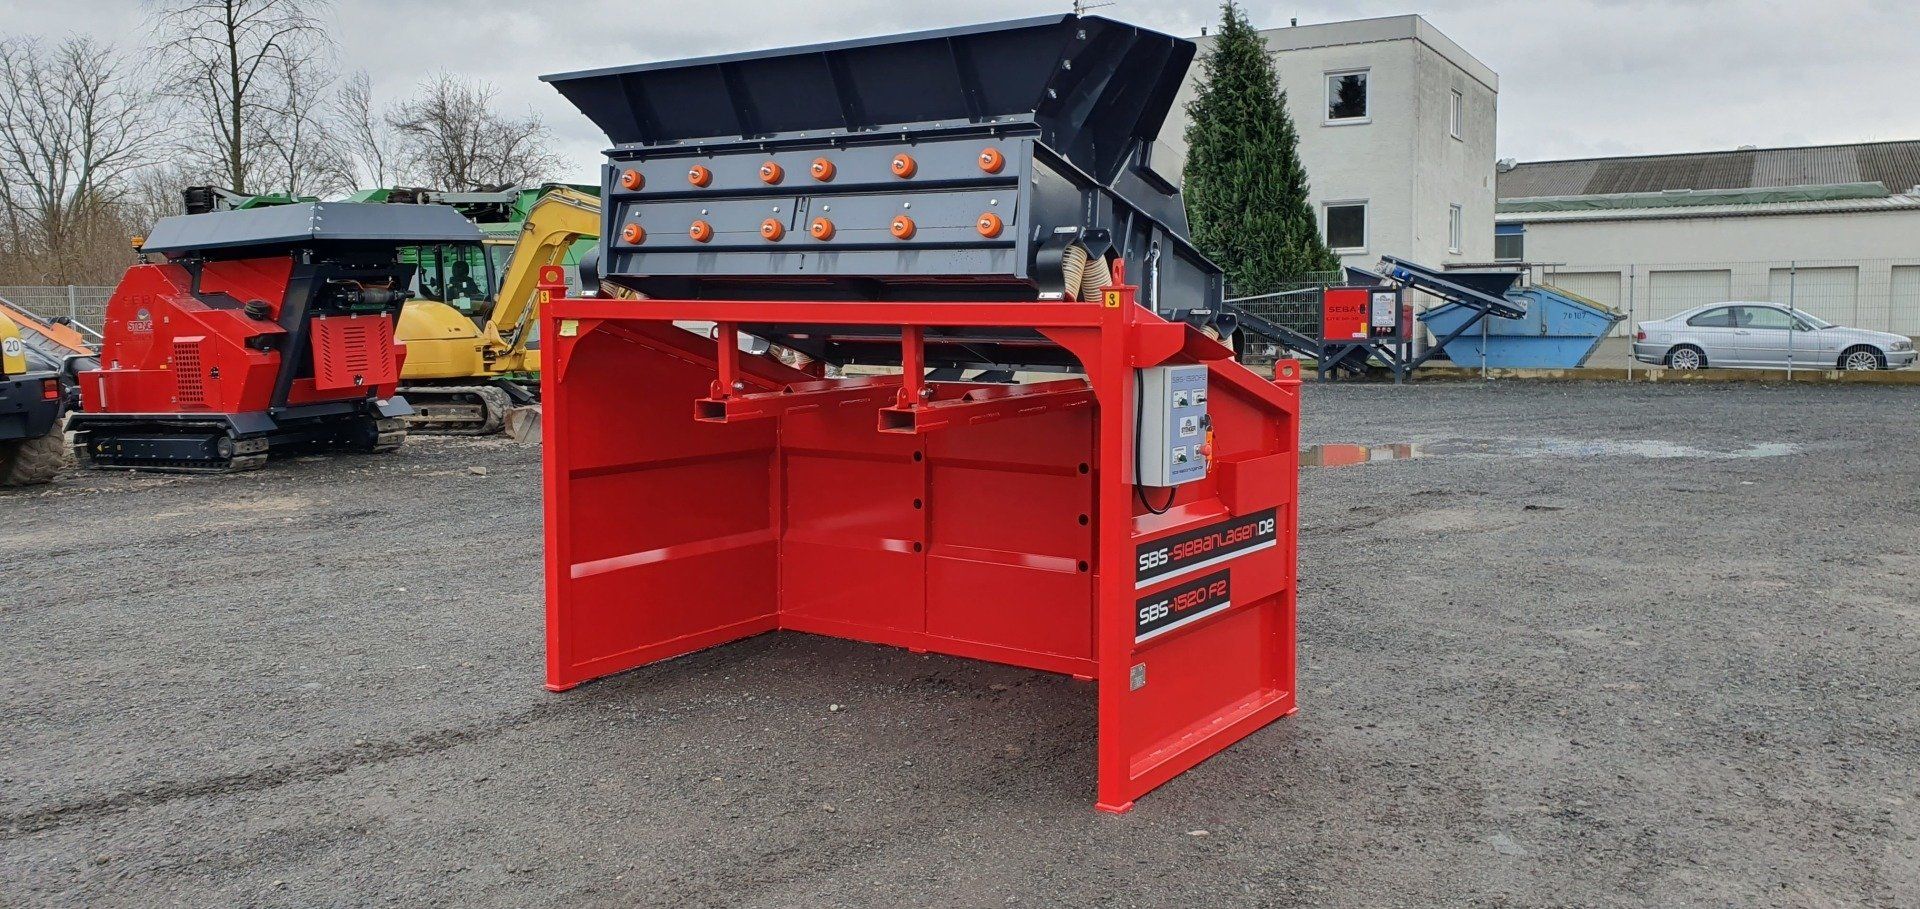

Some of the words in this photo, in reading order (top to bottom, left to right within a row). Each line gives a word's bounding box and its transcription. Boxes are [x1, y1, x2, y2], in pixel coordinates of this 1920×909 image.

[1328, 305, 1357, 314] SEBA
[5, 340, 20, 352] 20
[1139, 587, 1206, 626] SBS-1520
[1208, 579, 1227, 600] F2
